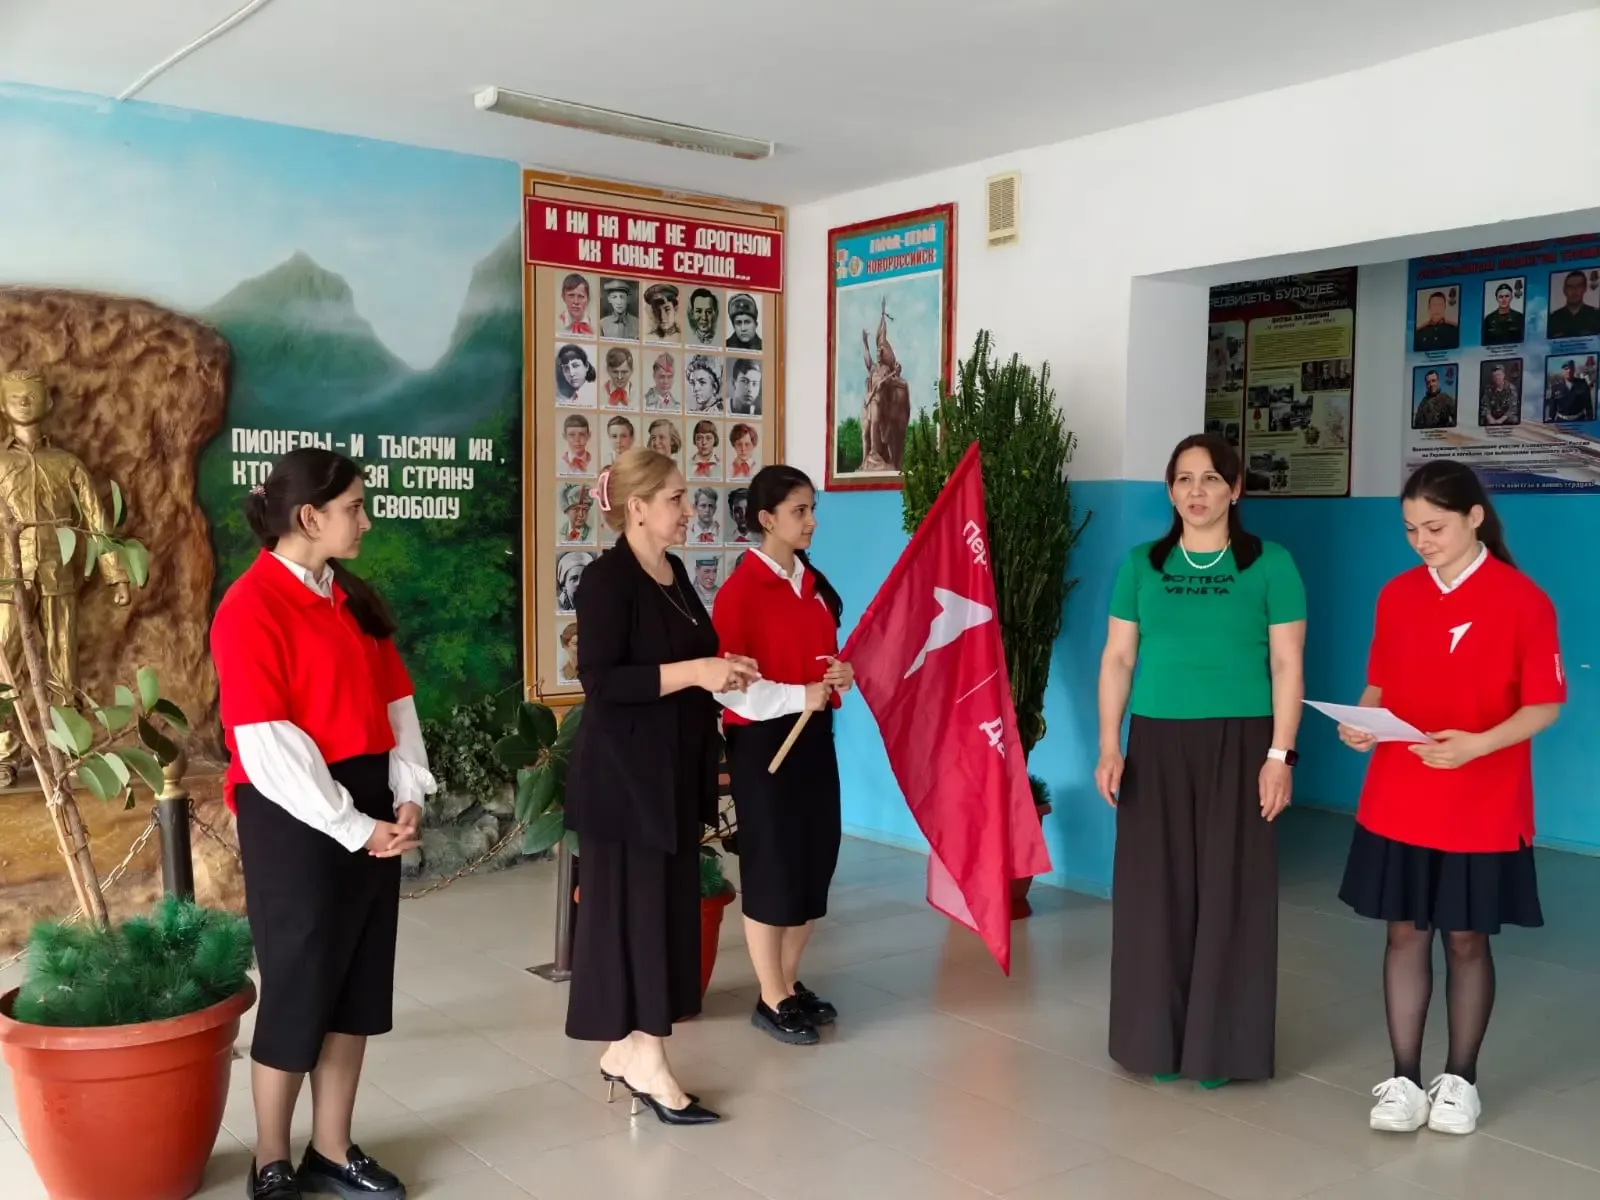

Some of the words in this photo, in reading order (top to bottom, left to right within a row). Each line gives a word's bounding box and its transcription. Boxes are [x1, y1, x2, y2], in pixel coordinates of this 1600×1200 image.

[545, 207, 558, 230] И
[566, 210, 589, 235] НИ
[597, 214, 619, 238] НА
[627, 218, 661, 244] МИГ
[665, 224, 687, 248] НЕ
[694, 227, 772, 257] ДРОГНУЛИ
[578, 238, 602, 263] ИХ
[612, 243, 664, 271] ЮНЫЕ
[673, 251, 751, 281] СЕРДЦА...
[866, 247, 937, 274] НОВОРОССИЙСК
[1275, 282, 1335, 300] БУДУЩЕЕ
[378, 435, 456, 460] ТЫСЯЧИ
[232, 460, 273, 485] КТО
[364, 465, 389, 488] ЗА
[402, 465, 474, 490] СТРАНУ
[372, 494, 460, 520] СВОБОДУ
[962, 519, 988, 574] Пер
[1161, 573, 1236, 584] BOTTEGA
[1164, 585, 1230, 596] VENETA
